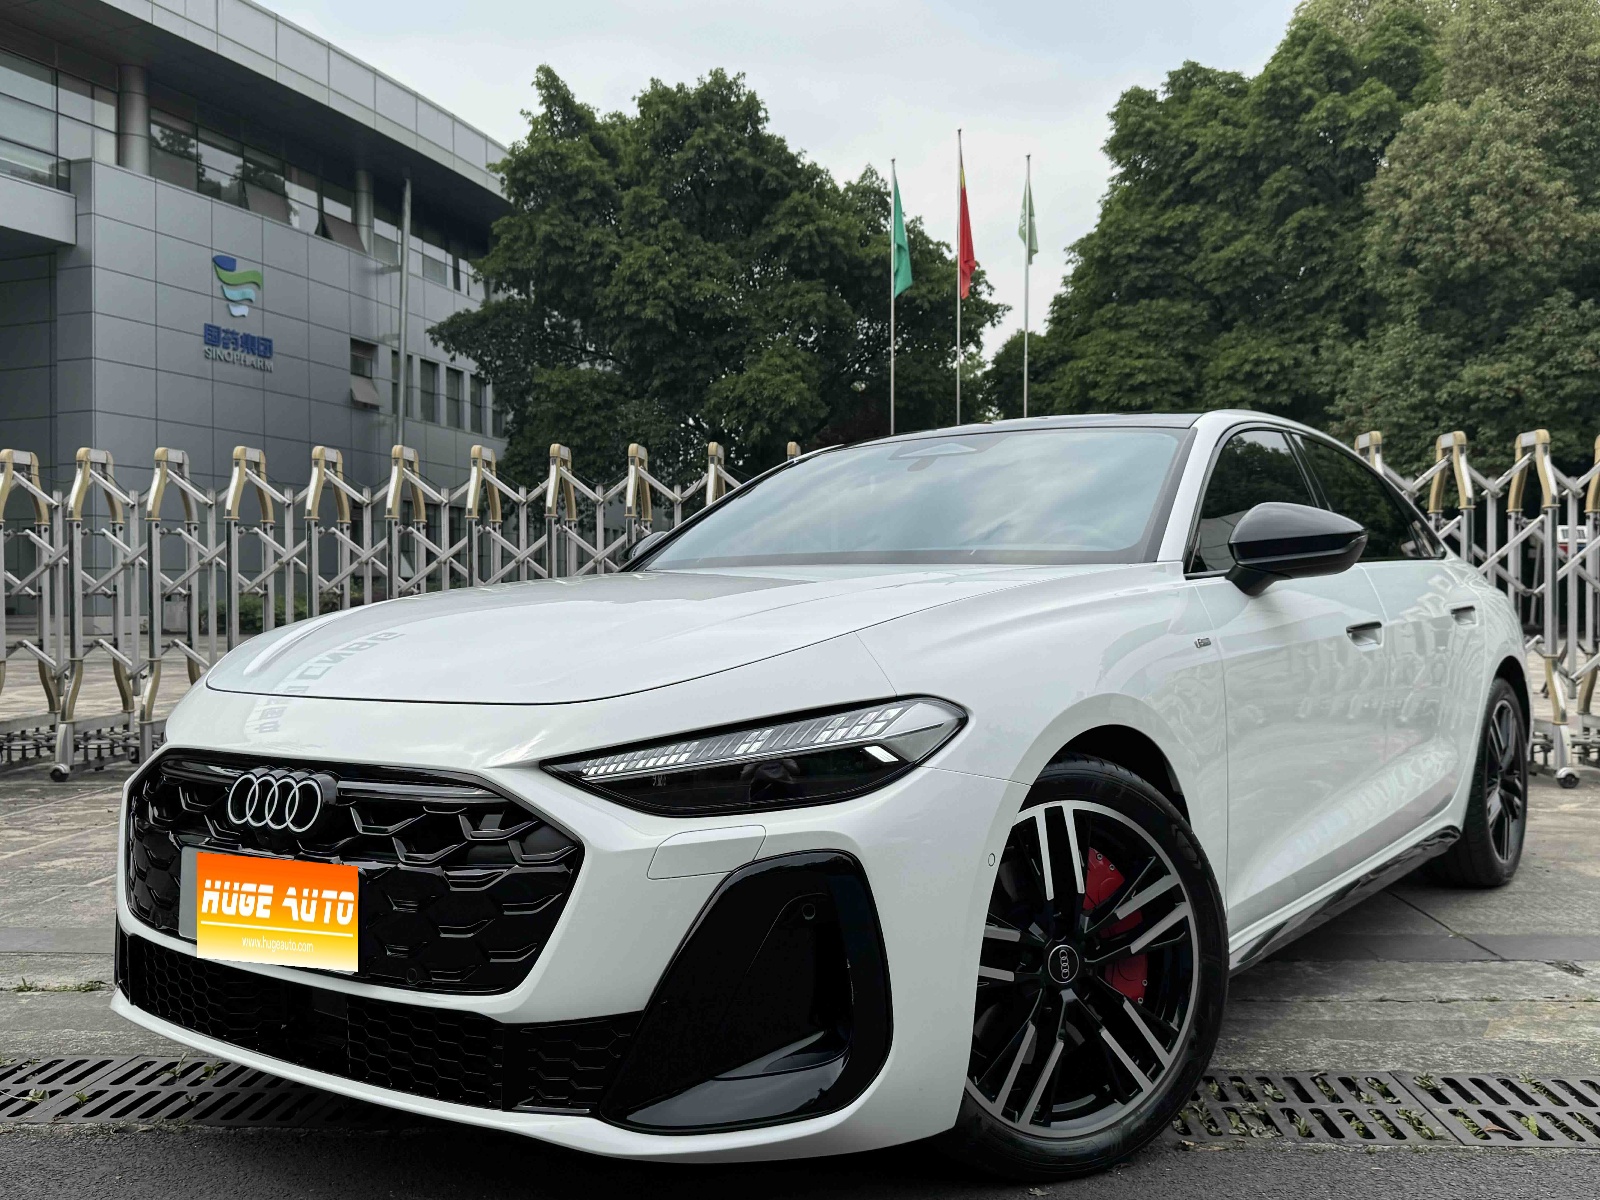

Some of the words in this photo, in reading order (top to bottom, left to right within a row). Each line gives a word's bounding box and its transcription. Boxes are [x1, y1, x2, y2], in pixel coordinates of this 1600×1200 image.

[204, 323, 273, 359] 国药集团
[204, 346, 274, 373] SINOPHARM
